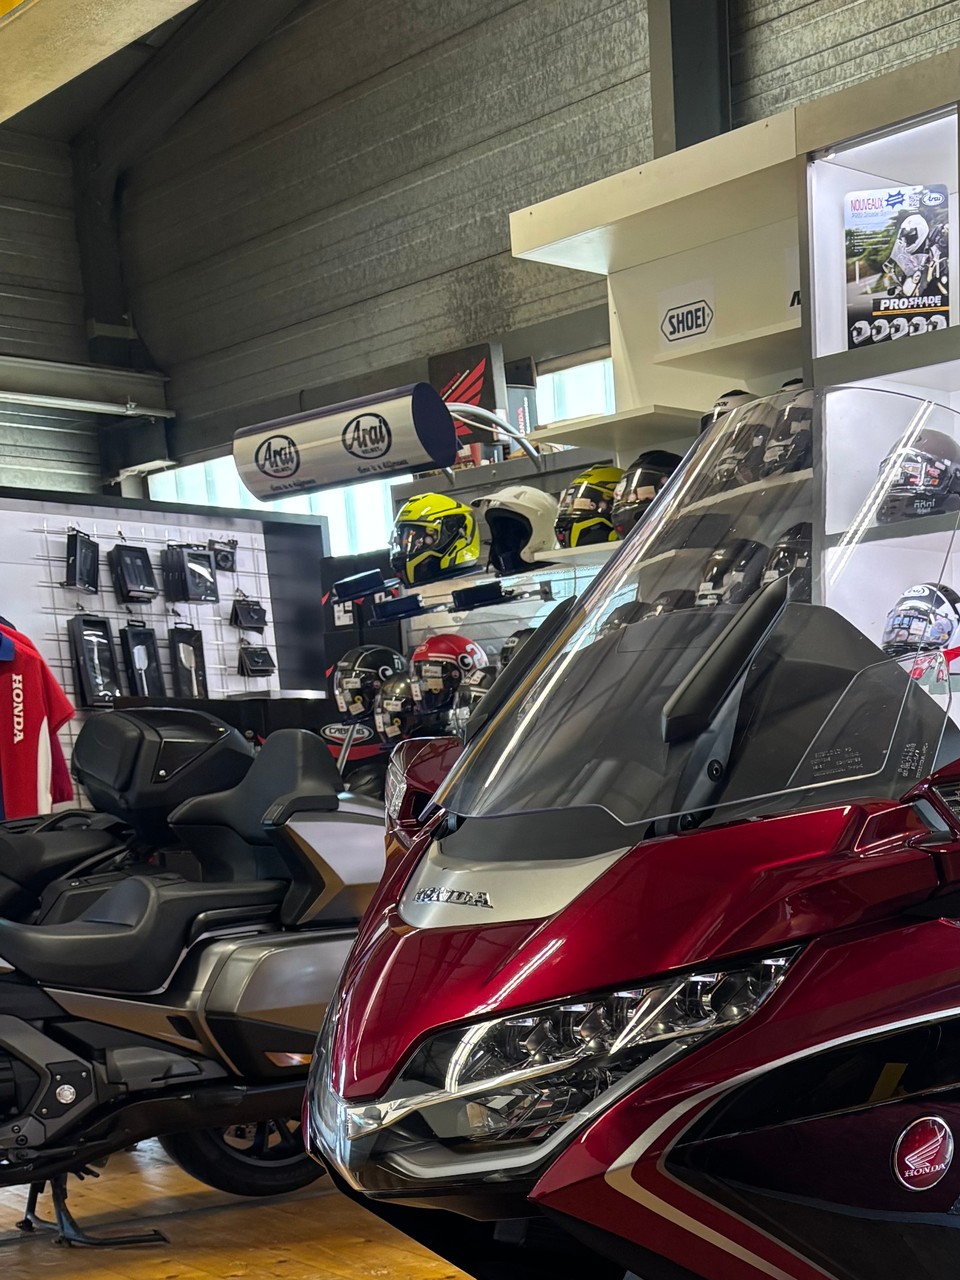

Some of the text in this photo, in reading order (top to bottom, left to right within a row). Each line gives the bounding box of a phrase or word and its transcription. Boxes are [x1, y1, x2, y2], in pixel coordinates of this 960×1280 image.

[850, 197, 884, 212] NOUVEAUX
[668, 306, 706, 336] SHOEI
[347, 417, 386, 451] Arai
[261, 438, 295, 471] Arai
[11, 673, 24, 744] HONDA
[904, 1163, 946, 1178] HONDA
